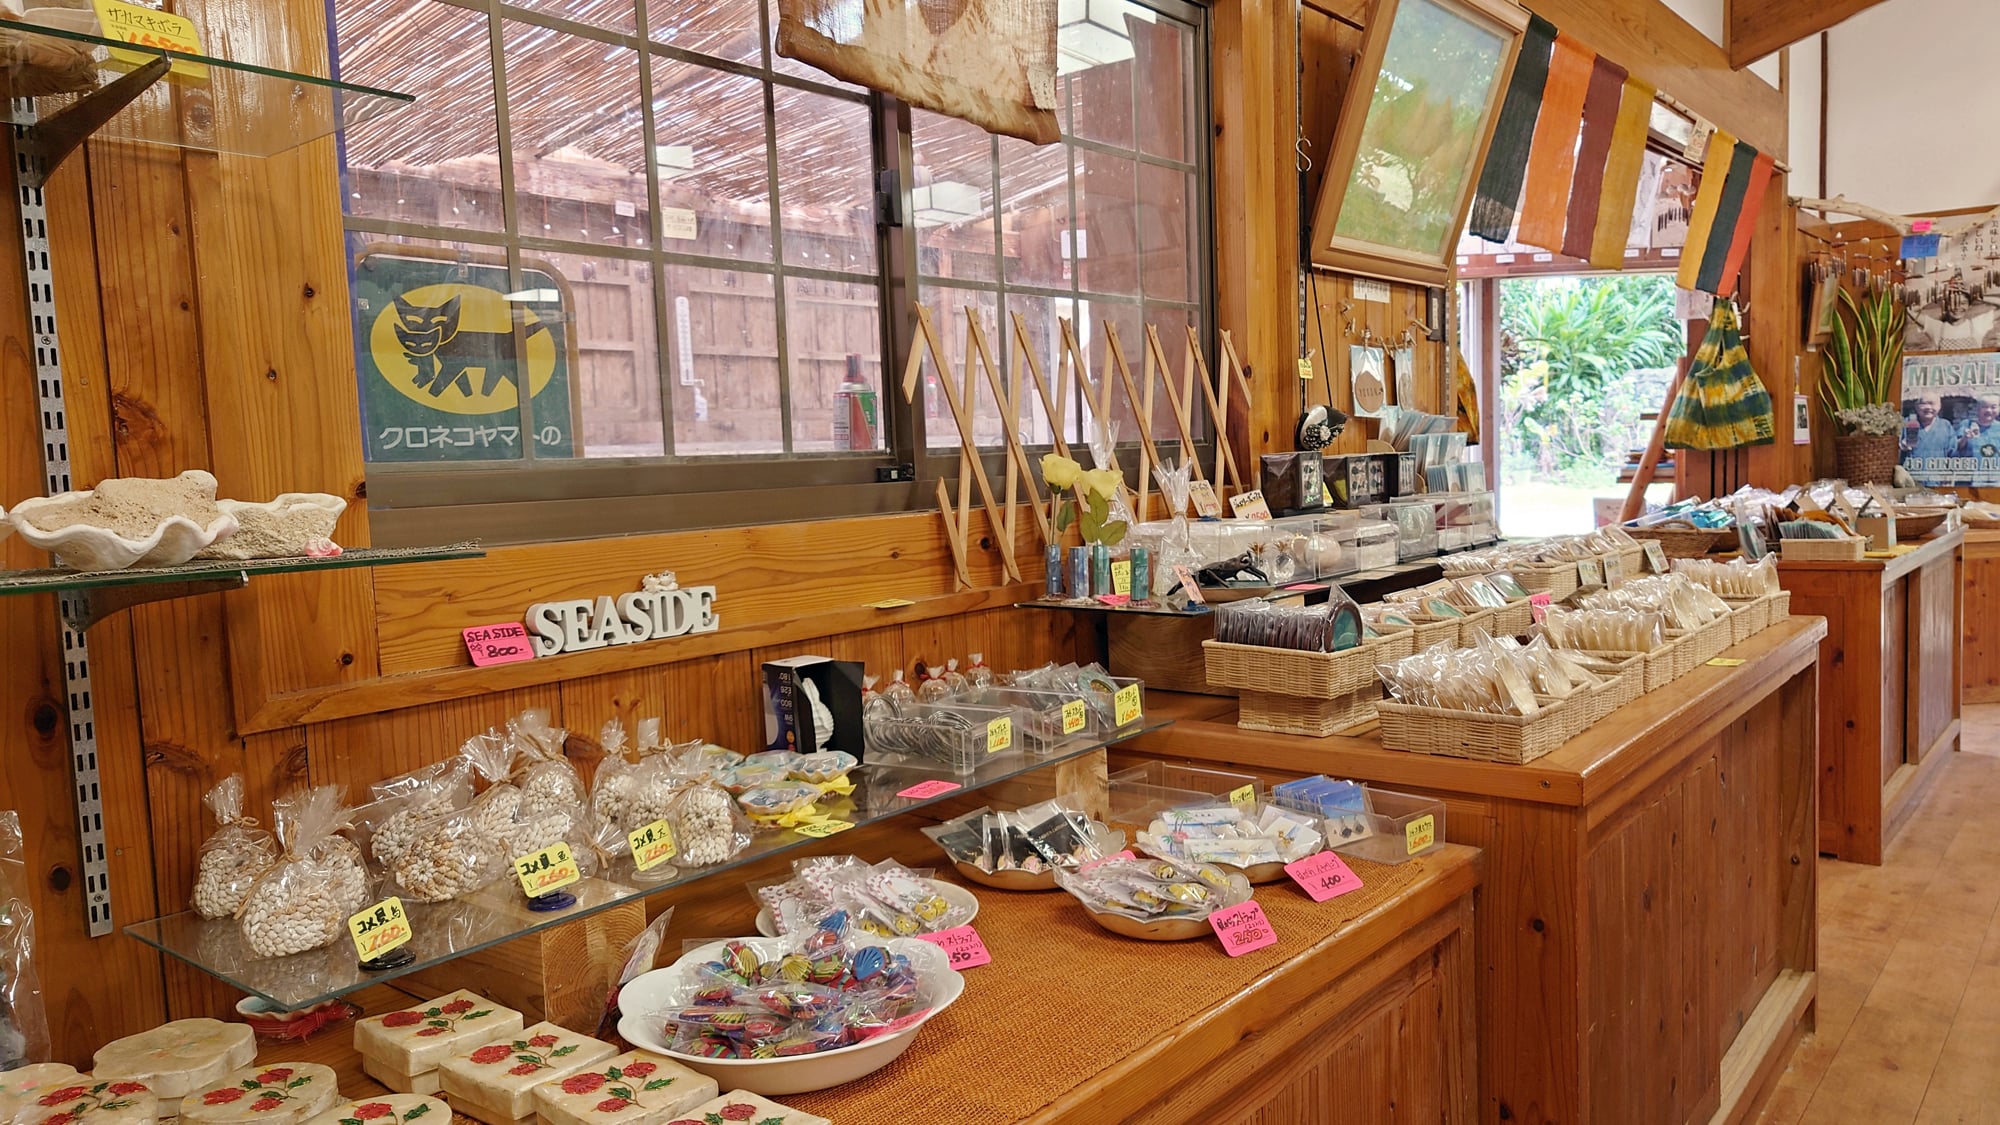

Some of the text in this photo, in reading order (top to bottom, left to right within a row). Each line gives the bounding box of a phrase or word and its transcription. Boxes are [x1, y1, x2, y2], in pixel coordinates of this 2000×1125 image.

[378, 425, 562, 450] クロネコヤマの
[525, 585, 720, 658] SEASIDE
